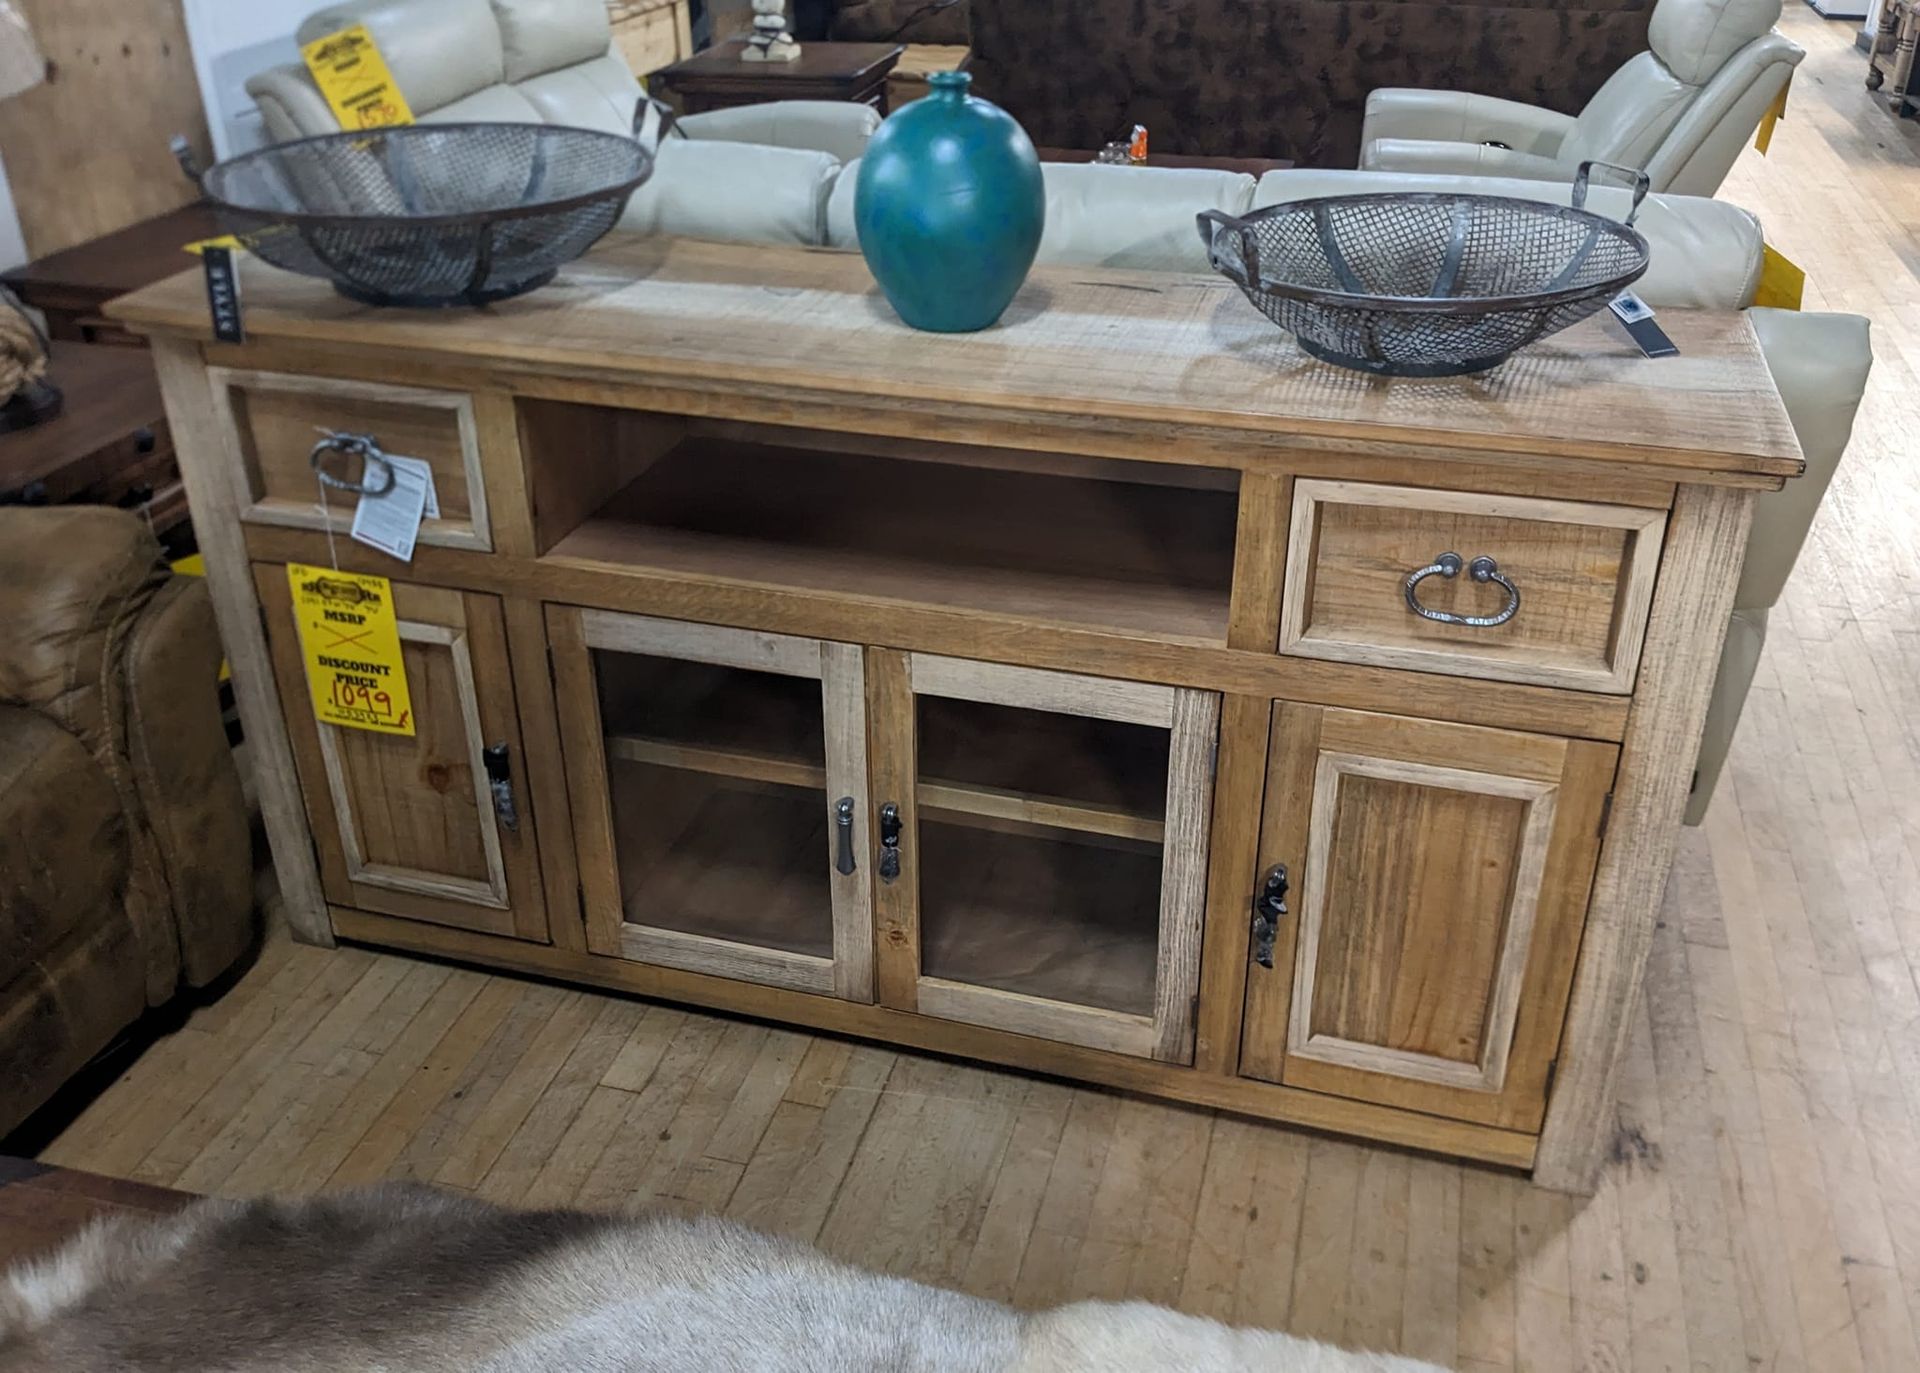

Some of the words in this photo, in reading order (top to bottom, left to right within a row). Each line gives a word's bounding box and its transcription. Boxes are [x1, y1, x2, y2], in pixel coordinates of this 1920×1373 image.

[323, 609, 367, 626] MSRP
[317, 655, 391, 676] DISCOUNT
[335, 672, 379, 689] PRICE
[333, 680, 392, 717] 1099
